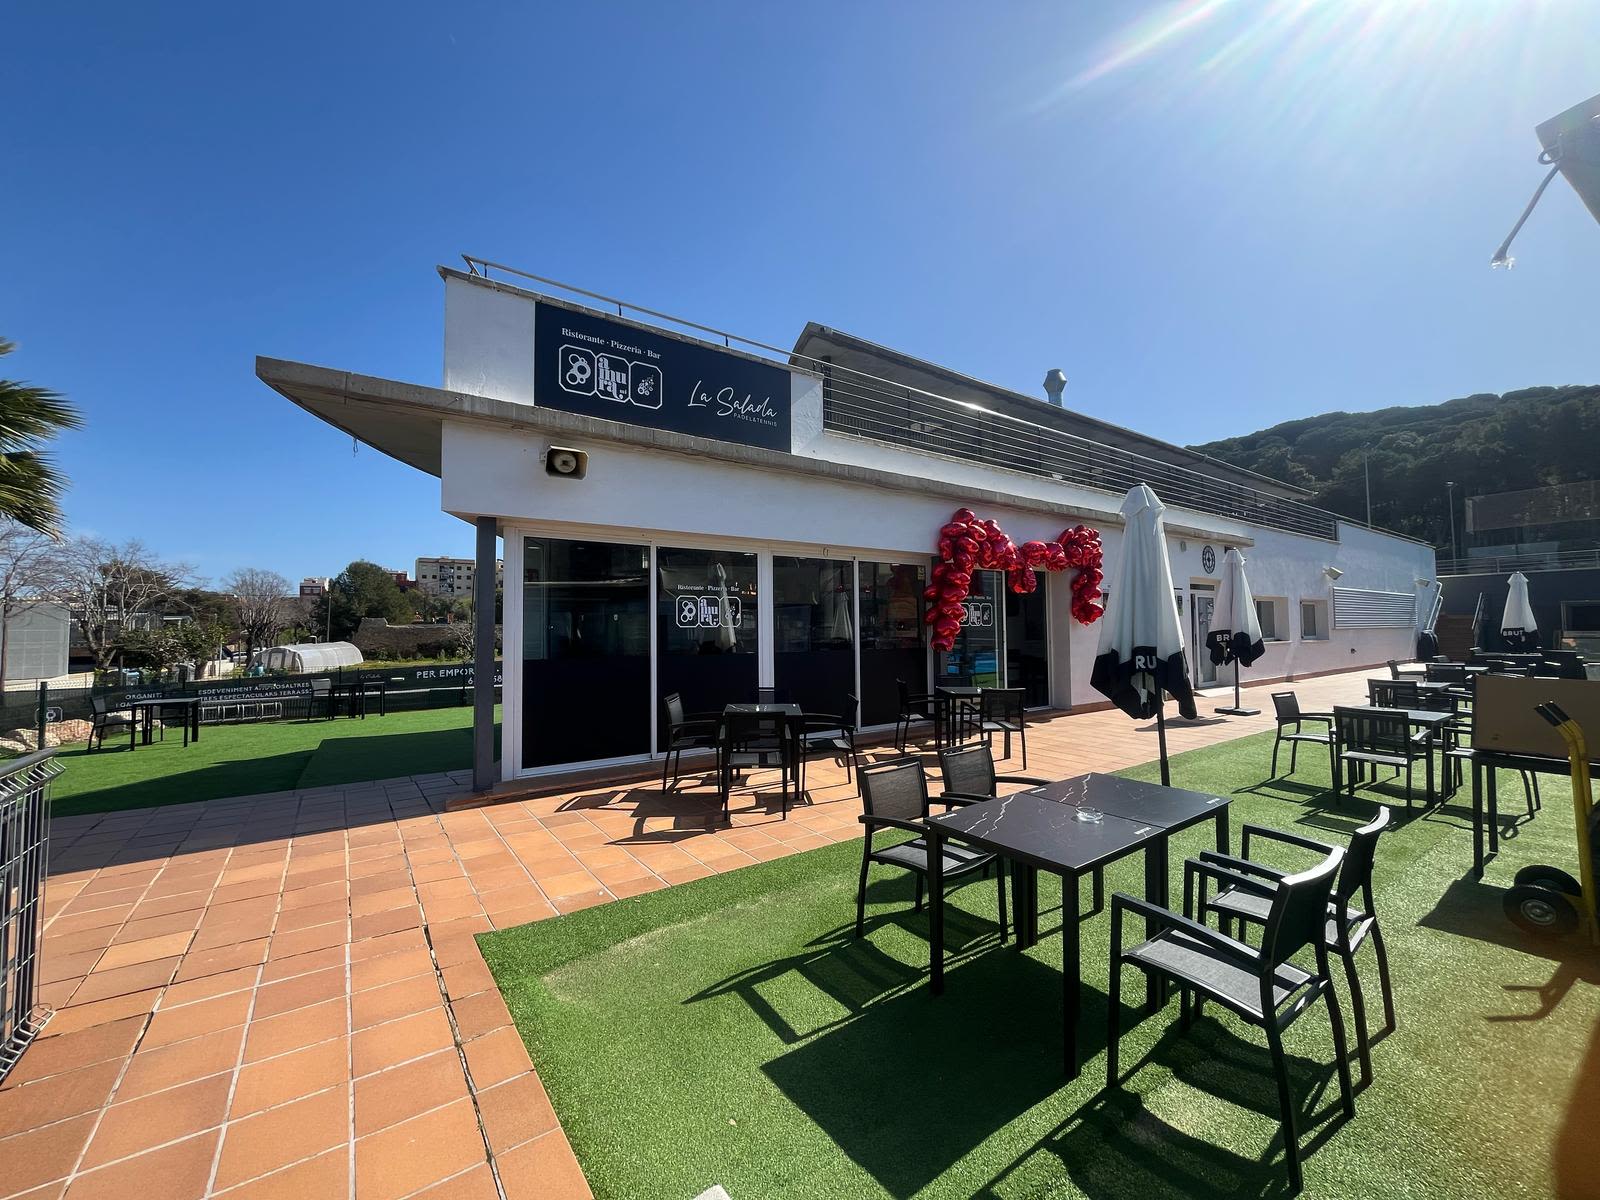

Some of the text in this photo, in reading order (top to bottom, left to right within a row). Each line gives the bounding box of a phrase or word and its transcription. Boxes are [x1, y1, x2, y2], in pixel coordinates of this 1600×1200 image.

[561, 327, 661, 360] Ristorante Pizzeria Bar
[687, 380, 778, 417] La Salada
[733, 413, 778, 427] PADEL&TENNIS
[1136, 655, 1157, 669] RU
[416, 668, 475, 679] PER EMPOR
[125, 692, 162, 700] ORGANIT
